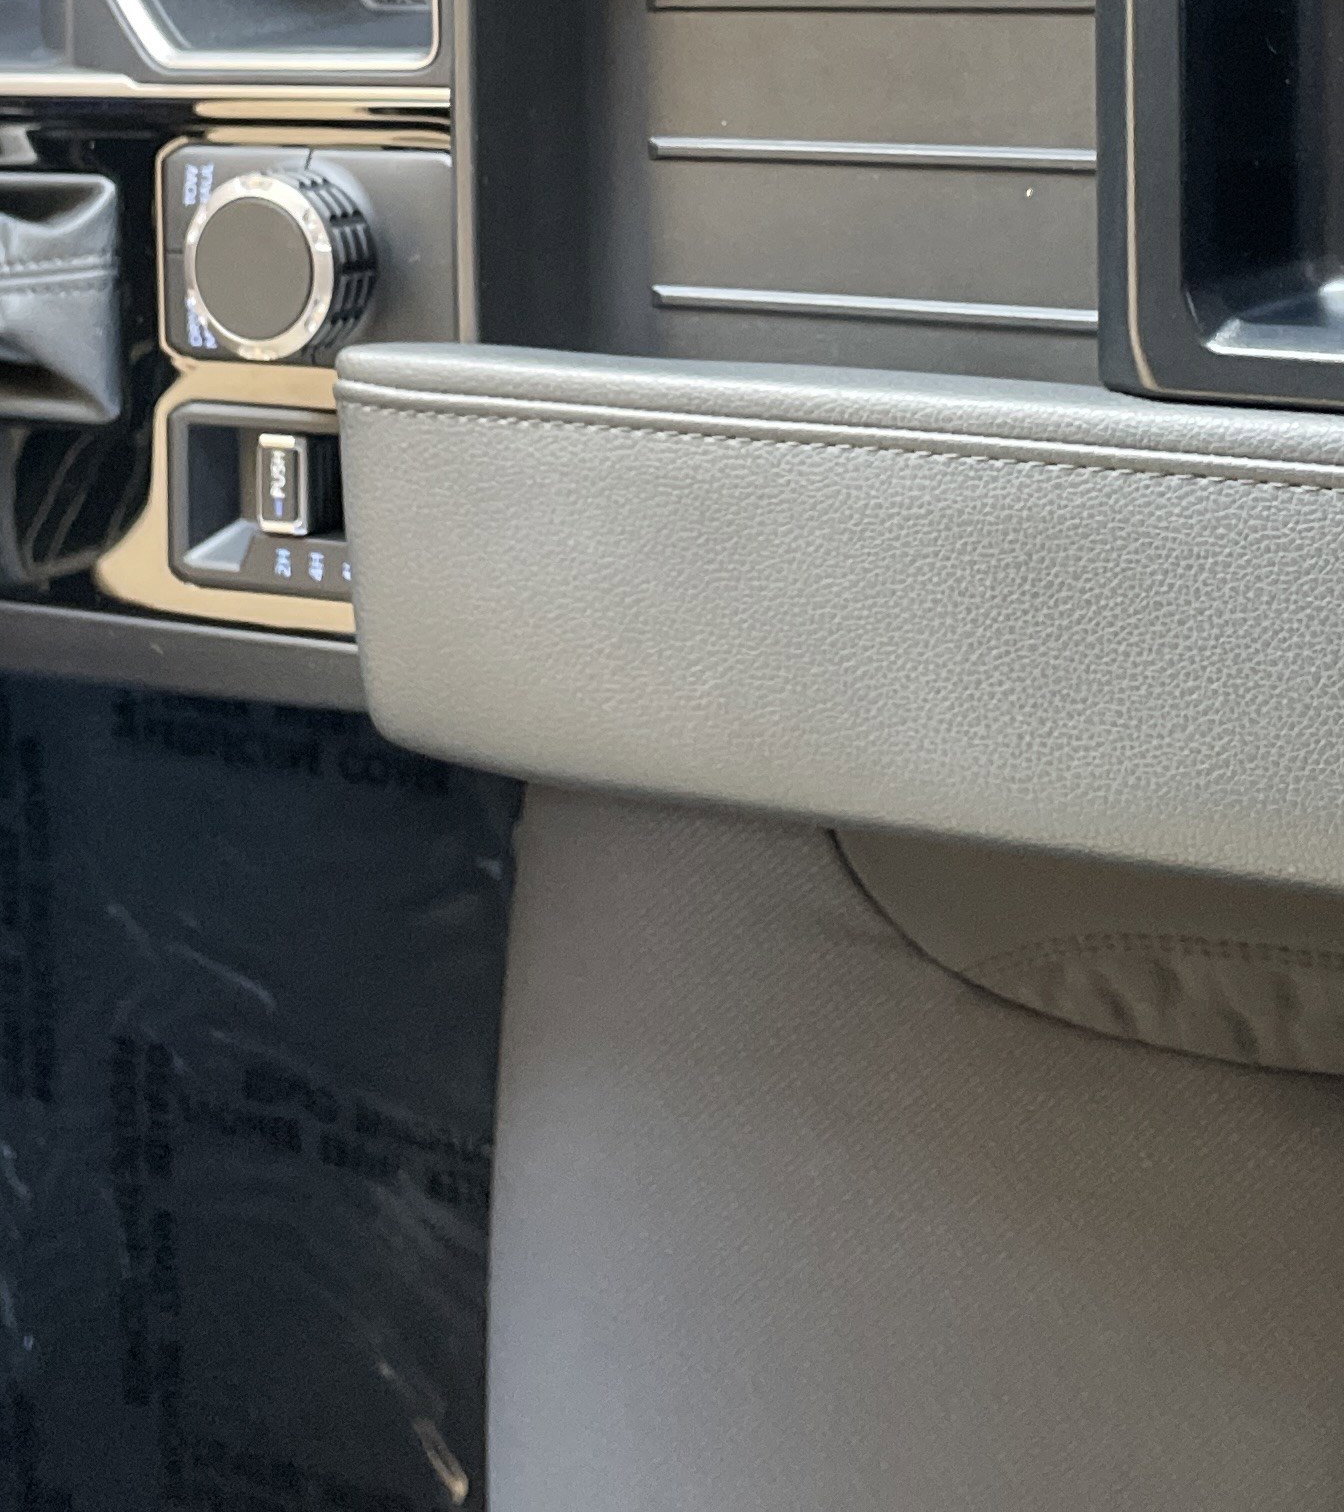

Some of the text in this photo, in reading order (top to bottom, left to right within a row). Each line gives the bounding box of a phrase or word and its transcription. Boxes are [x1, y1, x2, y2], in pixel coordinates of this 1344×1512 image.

[269, 449, 286, 499] PUSH
[274, 547, 292, 579] 2H
[308, 551, 325, 582] 4H
